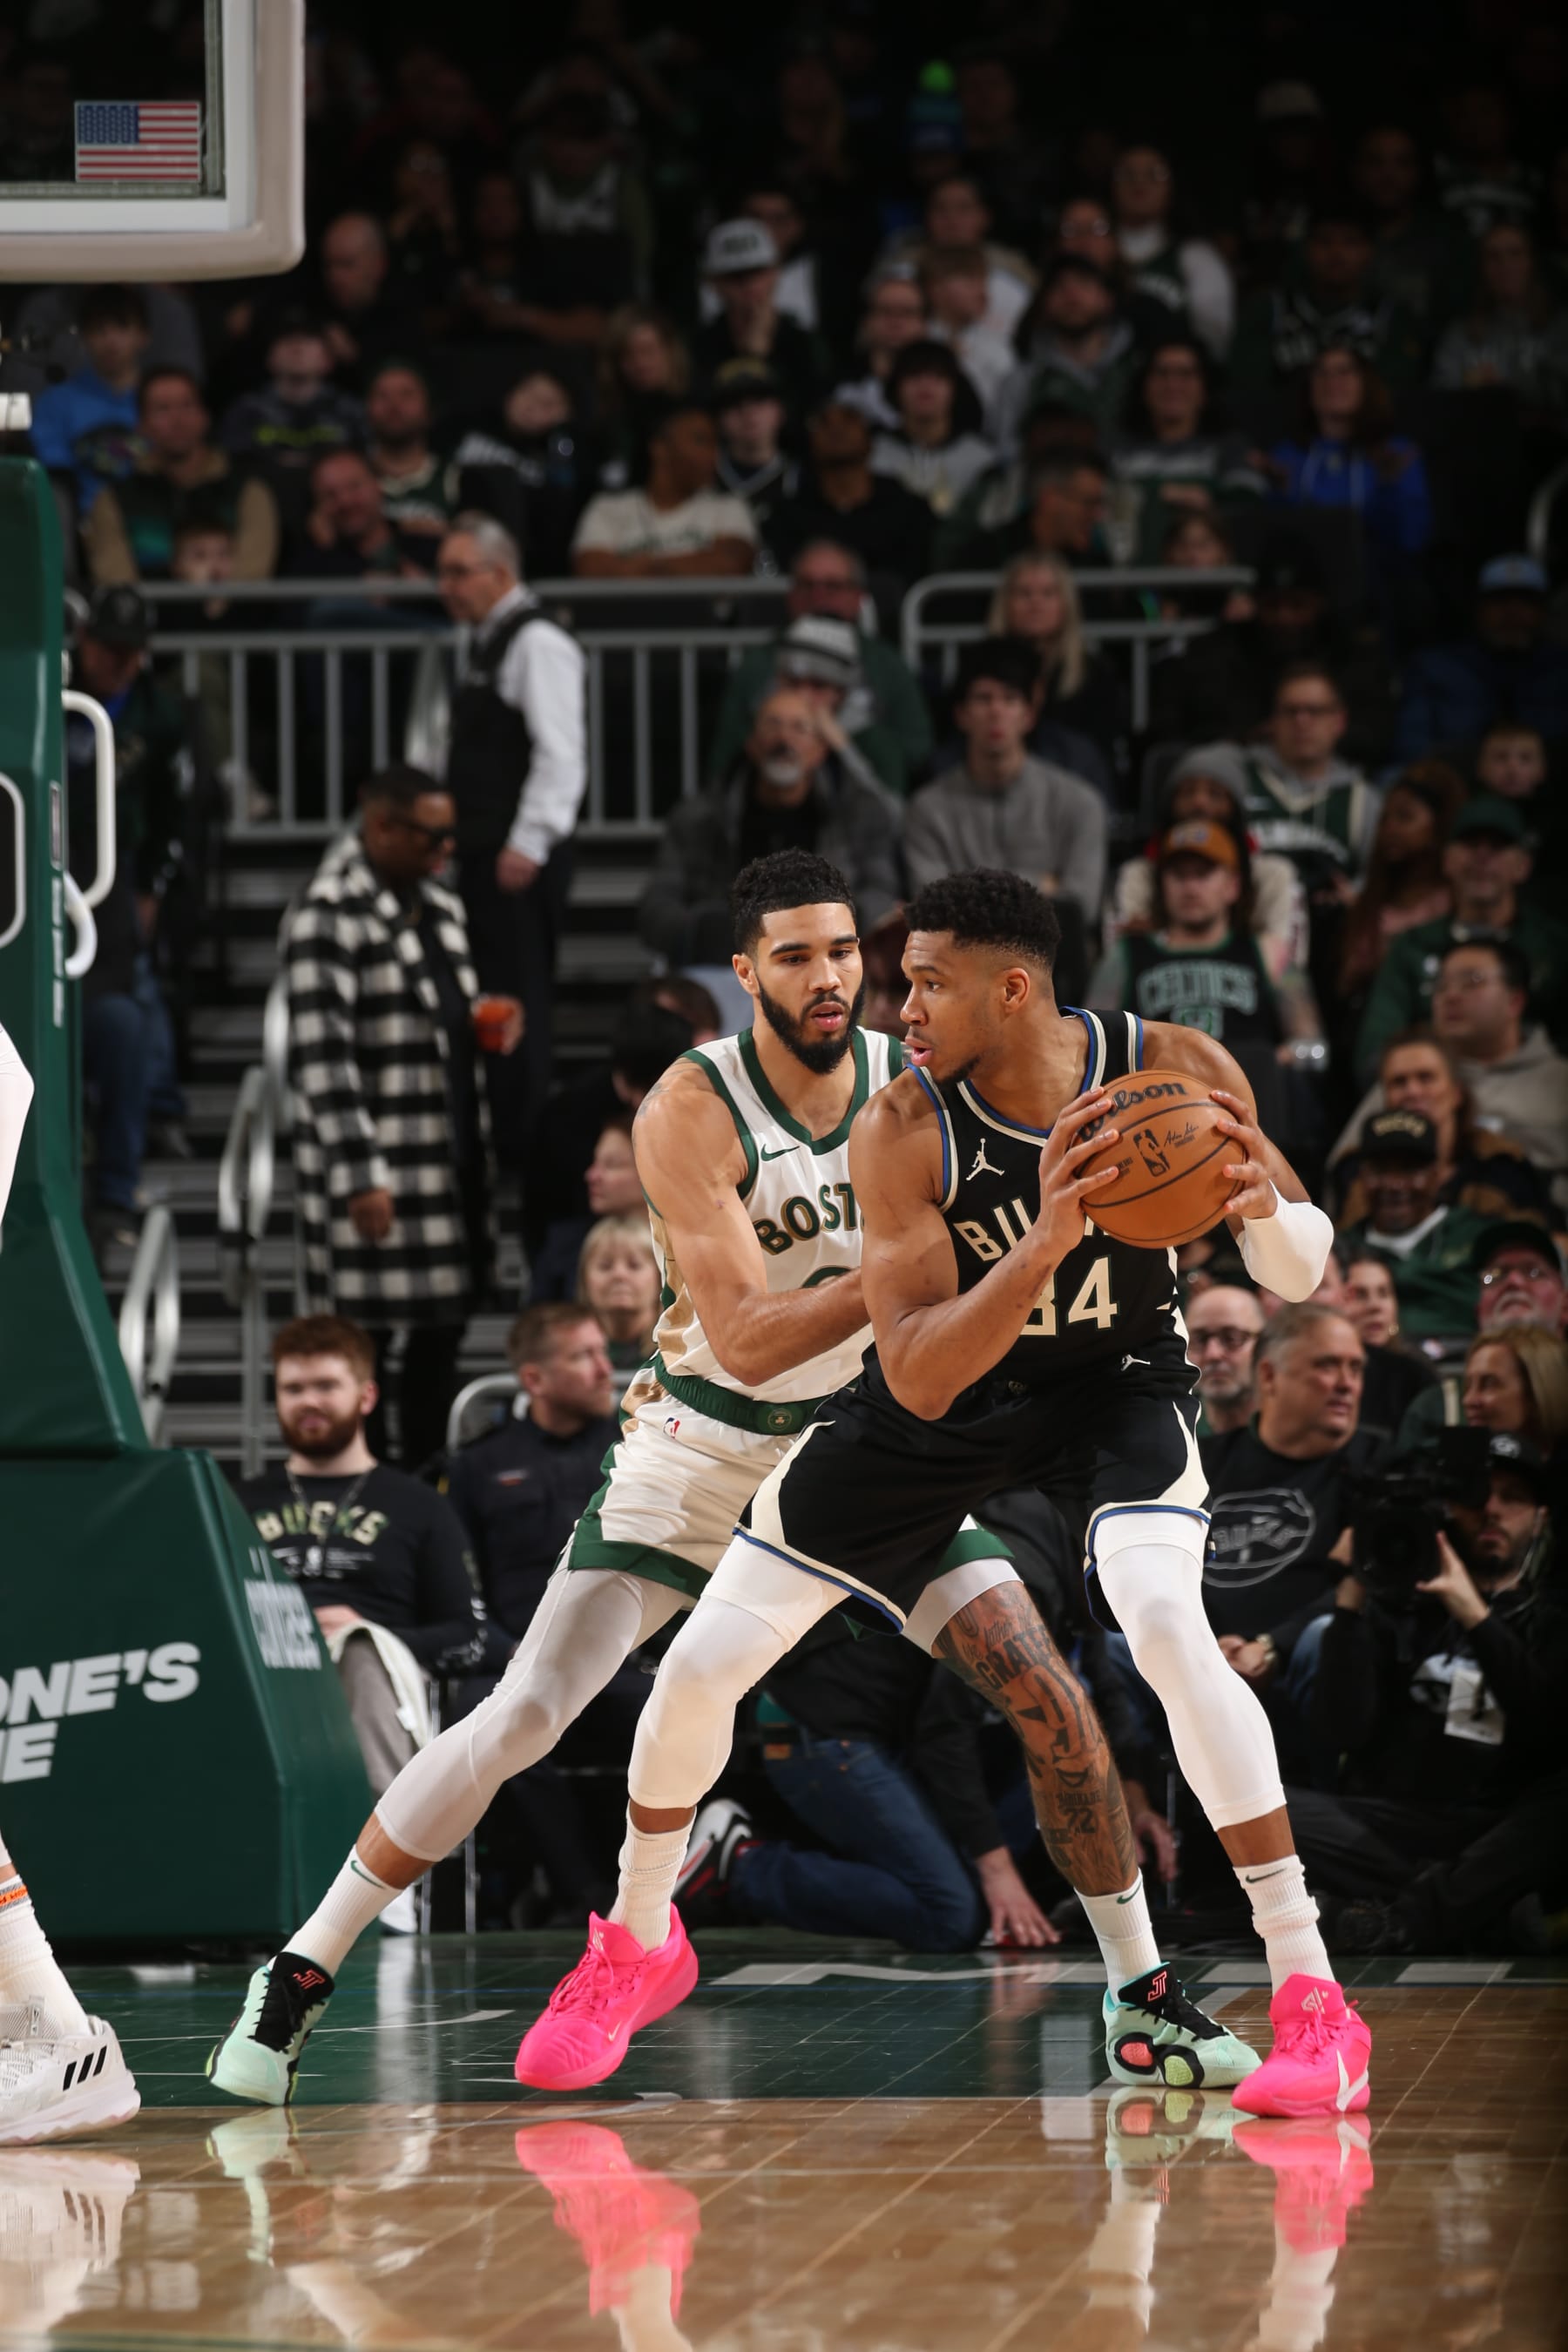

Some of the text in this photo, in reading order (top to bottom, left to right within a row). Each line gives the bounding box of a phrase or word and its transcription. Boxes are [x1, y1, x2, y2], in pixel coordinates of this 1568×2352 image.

[1138, 960, 1256, 1016] CELTICS
[753, 1183, 864, 1255] BOST
[254, 1501, 389, 1545] BUCKS
[0, 1641, 201, 1726] NE'S
[0, 1720, 58, 1784] E
